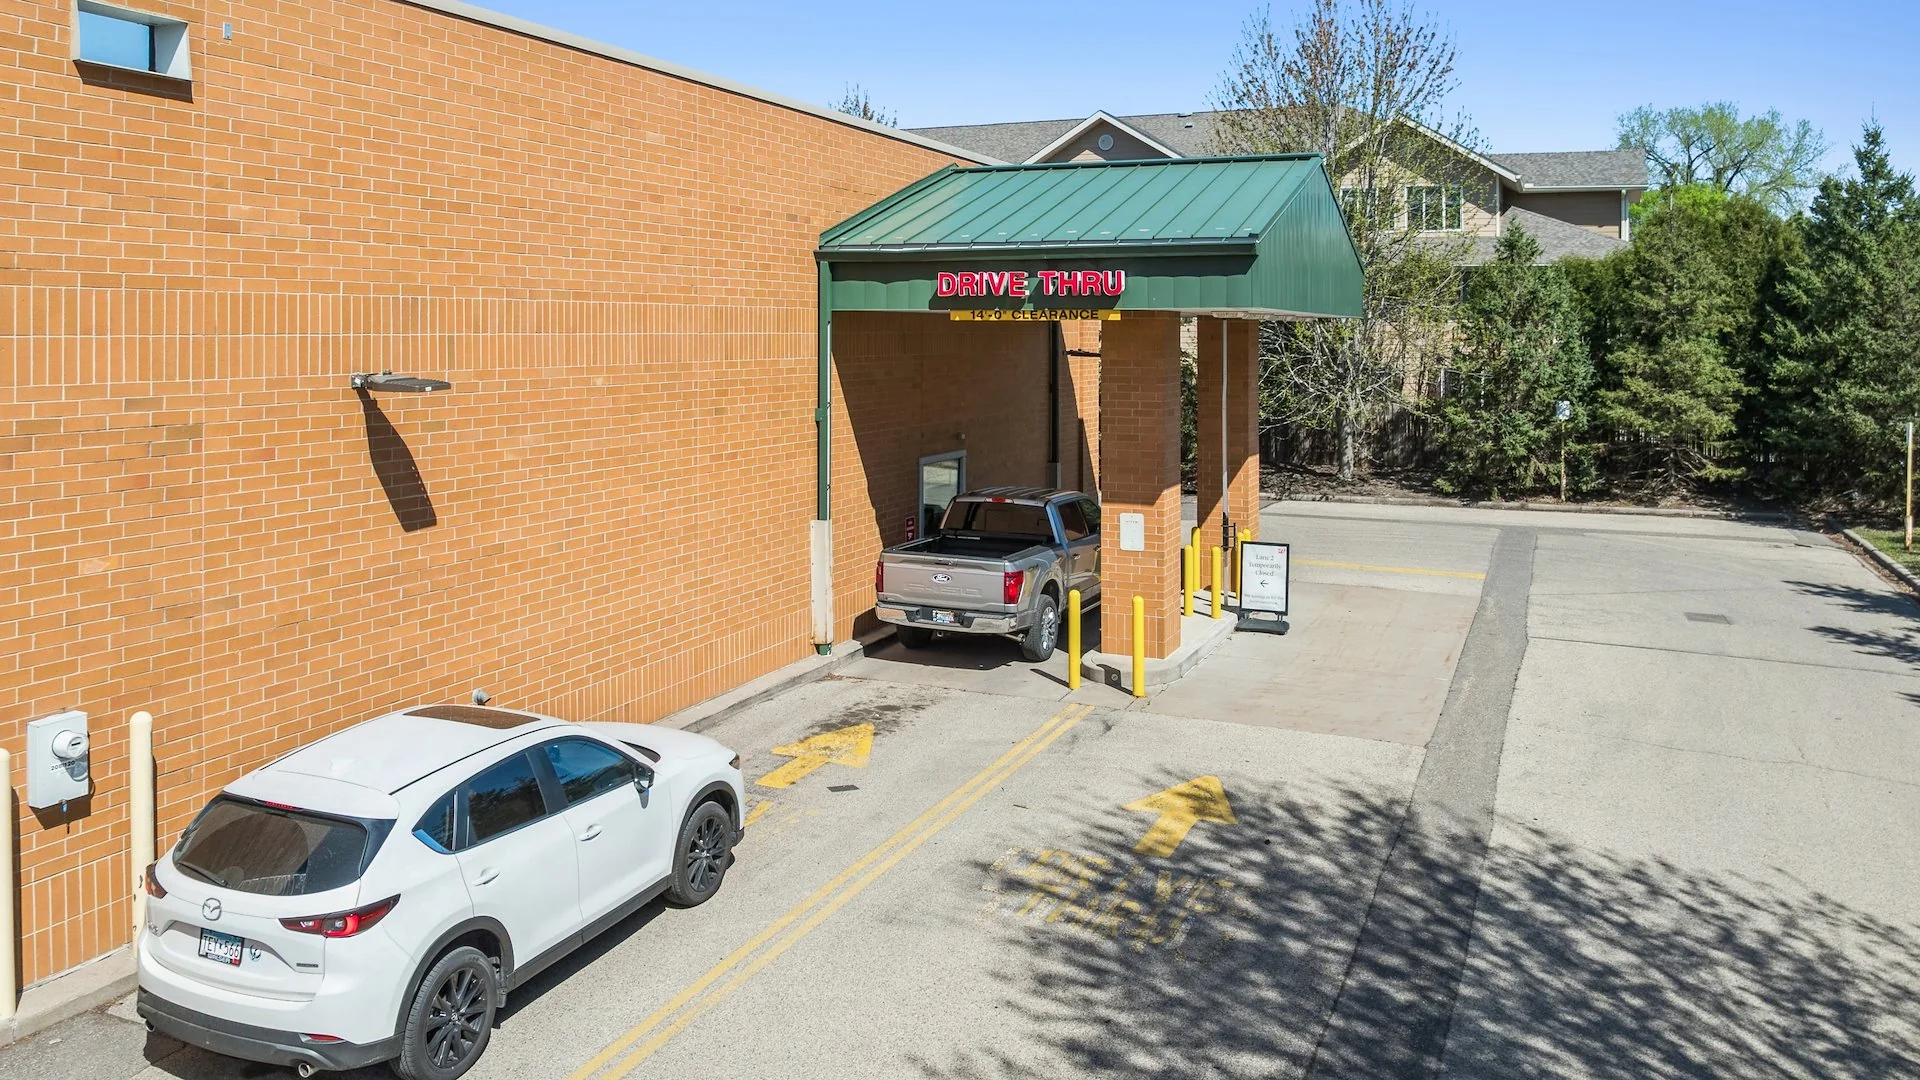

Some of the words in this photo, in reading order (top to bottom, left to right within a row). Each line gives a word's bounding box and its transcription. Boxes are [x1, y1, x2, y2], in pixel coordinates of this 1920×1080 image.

[937, 271, 1029, 297] DRIVE
[1038, 269, 1126, 296] THRU
[1011, 309, 1098, 320] CLEARANCE
